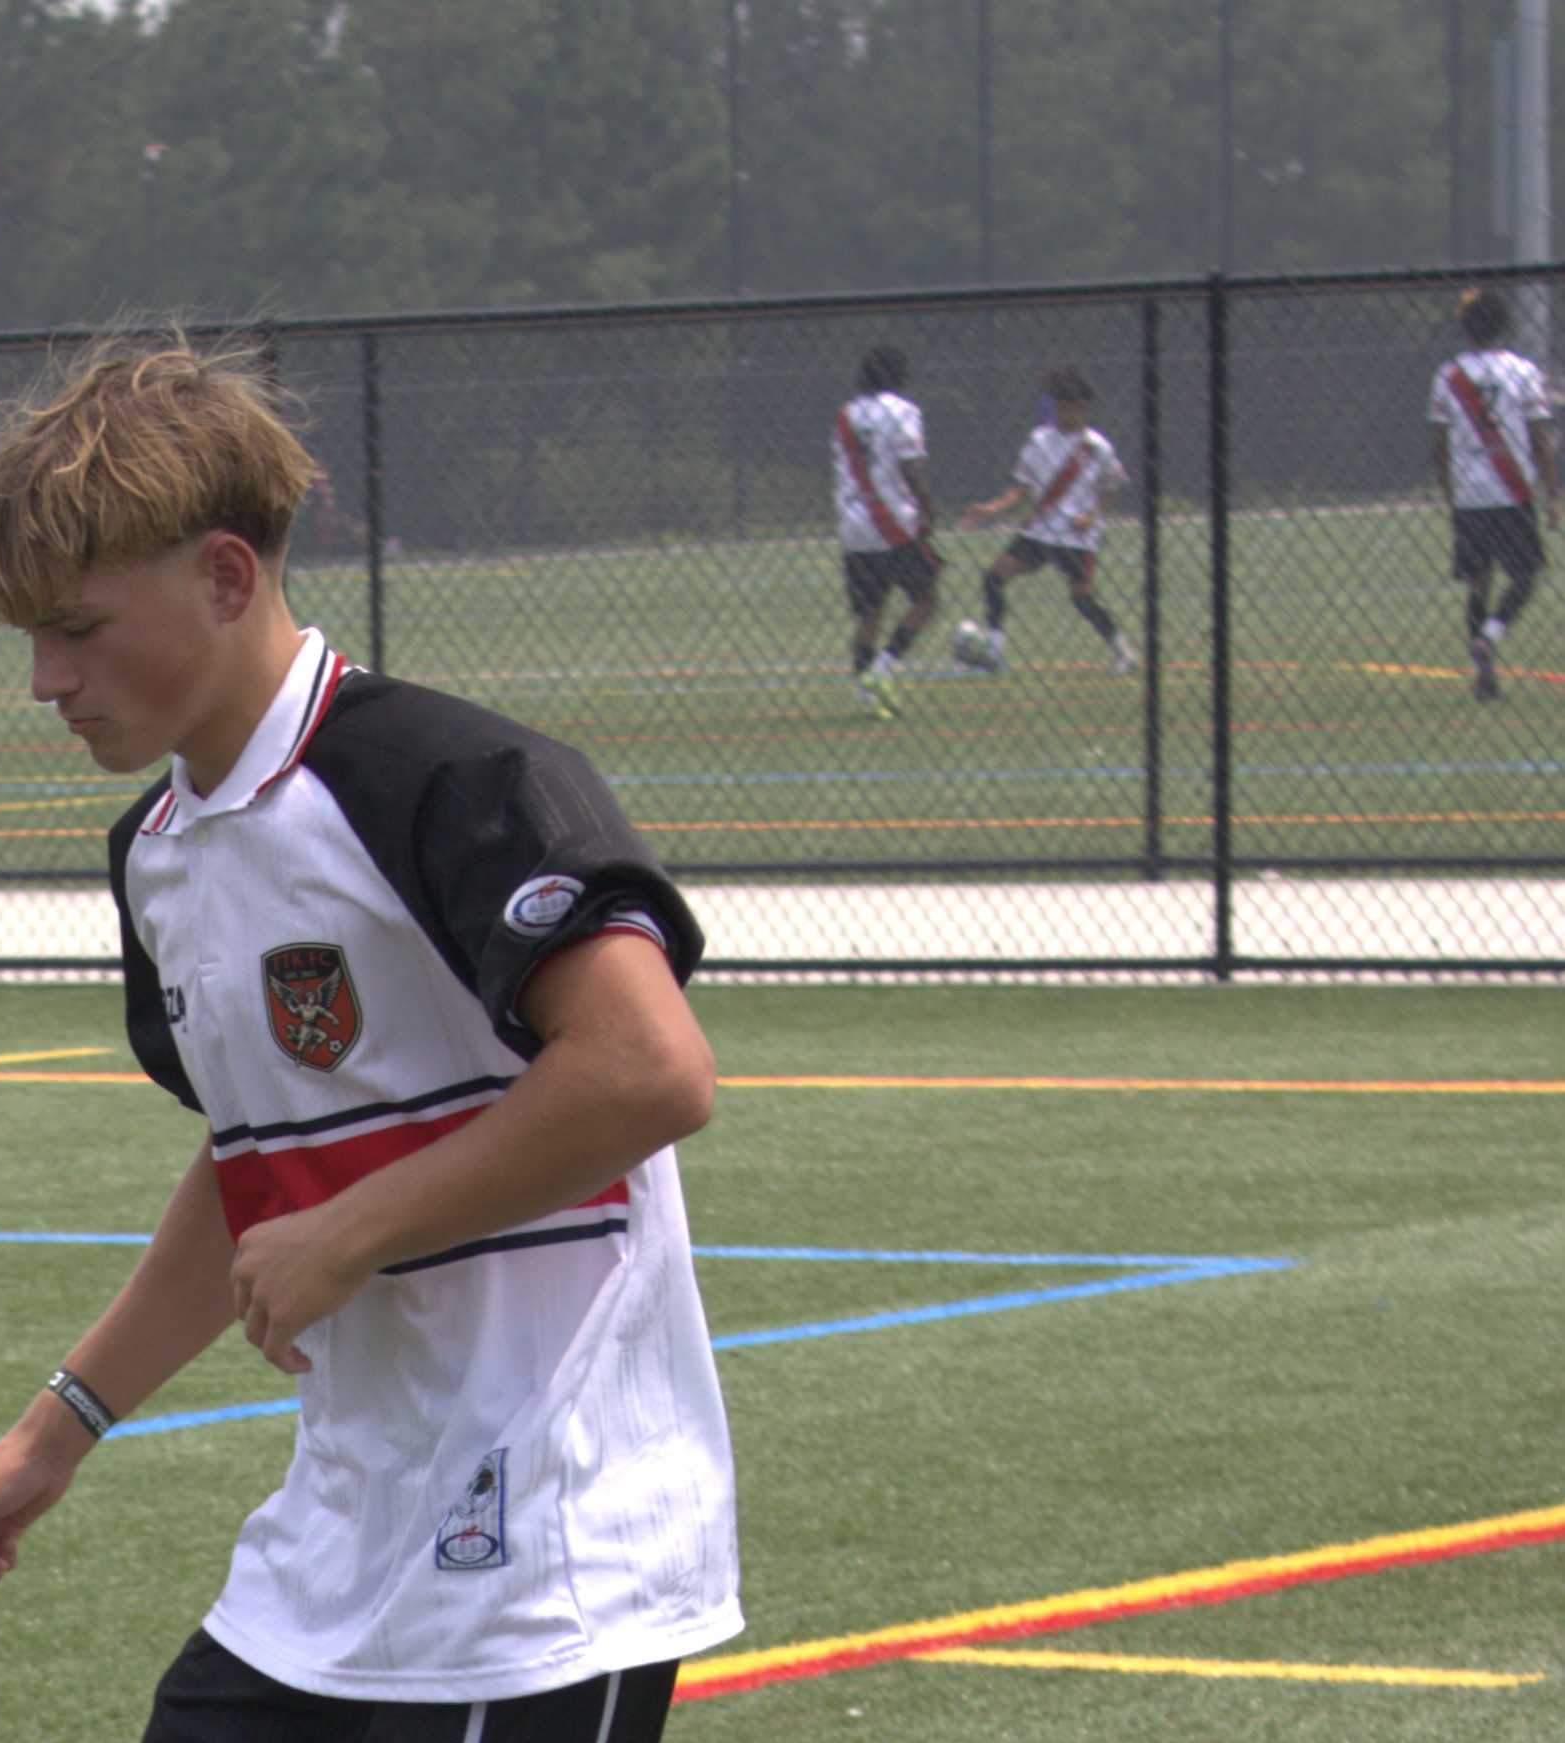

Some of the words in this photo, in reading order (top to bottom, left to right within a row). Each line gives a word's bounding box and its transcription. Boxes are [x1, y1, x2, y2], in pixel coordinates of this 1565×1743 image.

[272, 951, 304, 973] TTK
[307, 949, 332, 967] FC
[162, 985, 187, 1024] ZA
